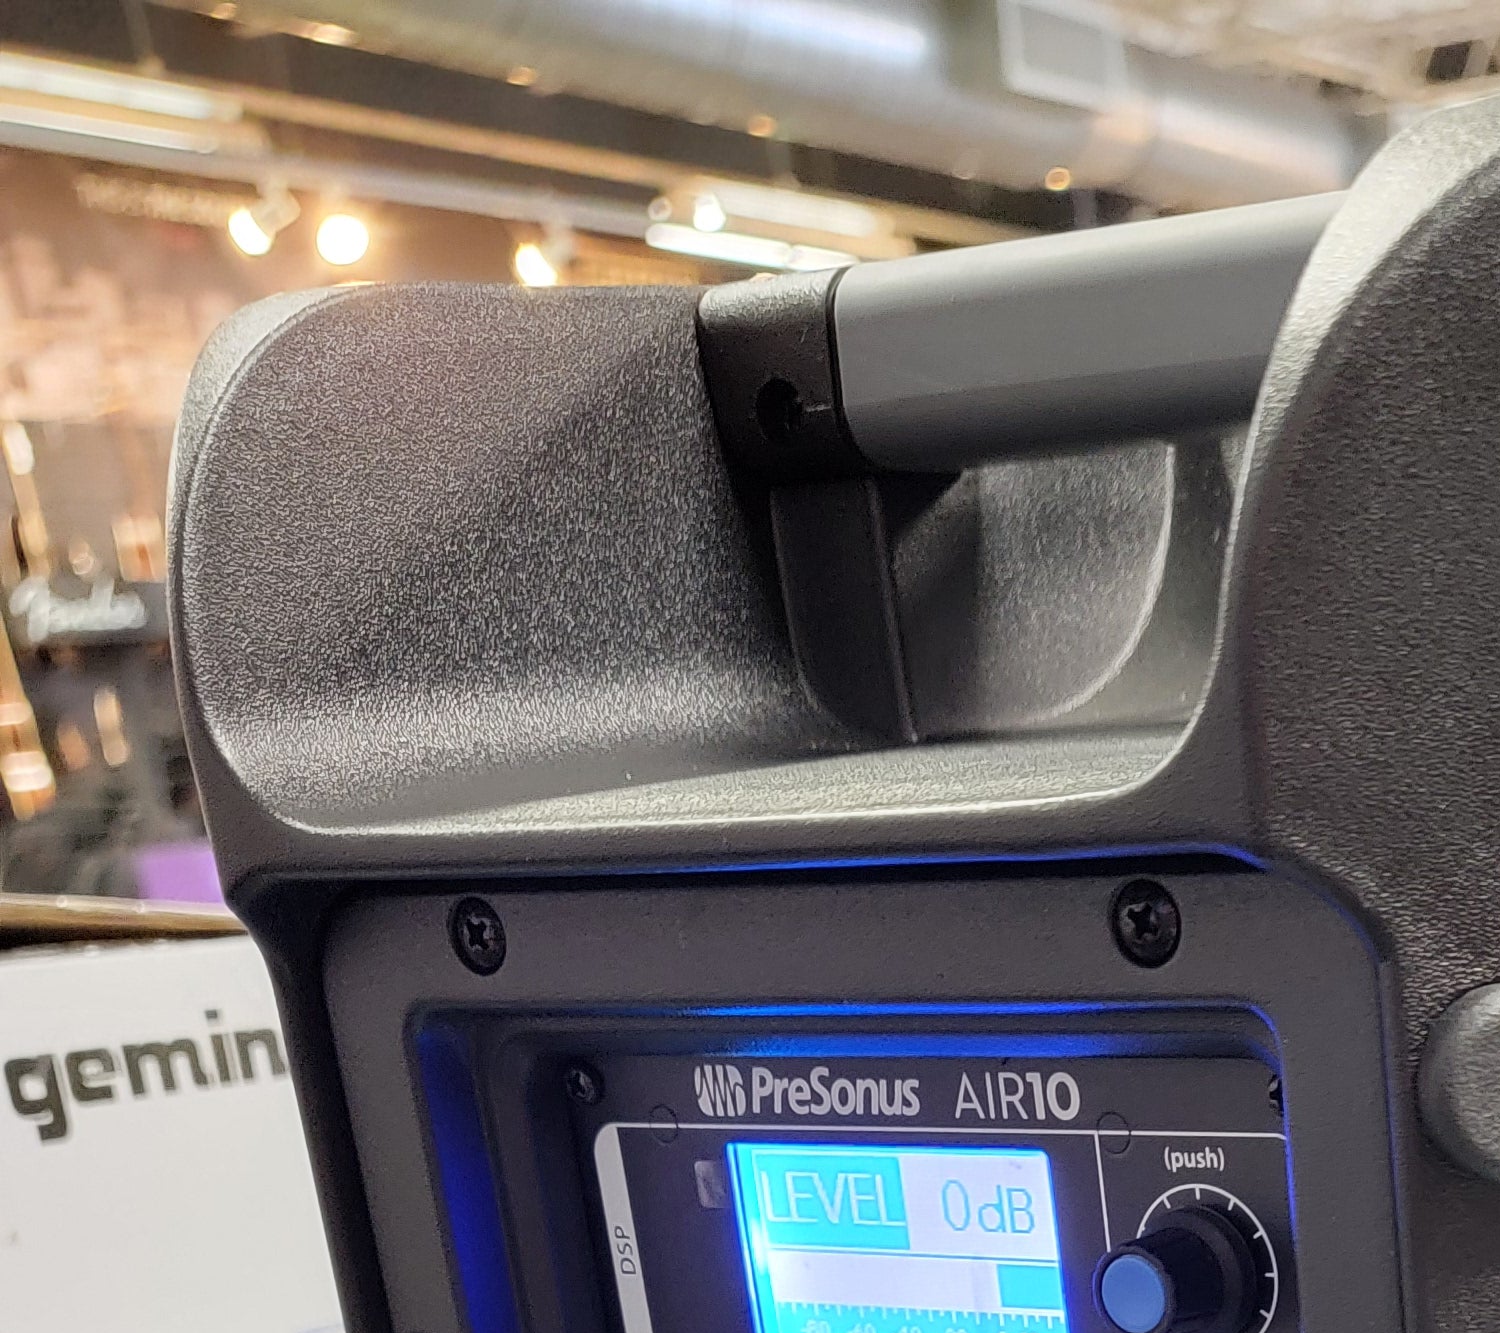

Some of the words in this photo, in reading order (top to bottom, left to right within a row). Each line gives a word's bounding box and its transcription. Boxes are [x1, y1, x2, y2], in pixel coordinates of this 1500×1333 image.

[751, 1066, 921, 1117] PreSonus
[954, 1071, 1081, 1121] AIR10
[1164, 1146, 1225, 1173] (push)
[760, 1170, 907, 1227] LEVEL
[614, 1225, 637, 1276] DSP
